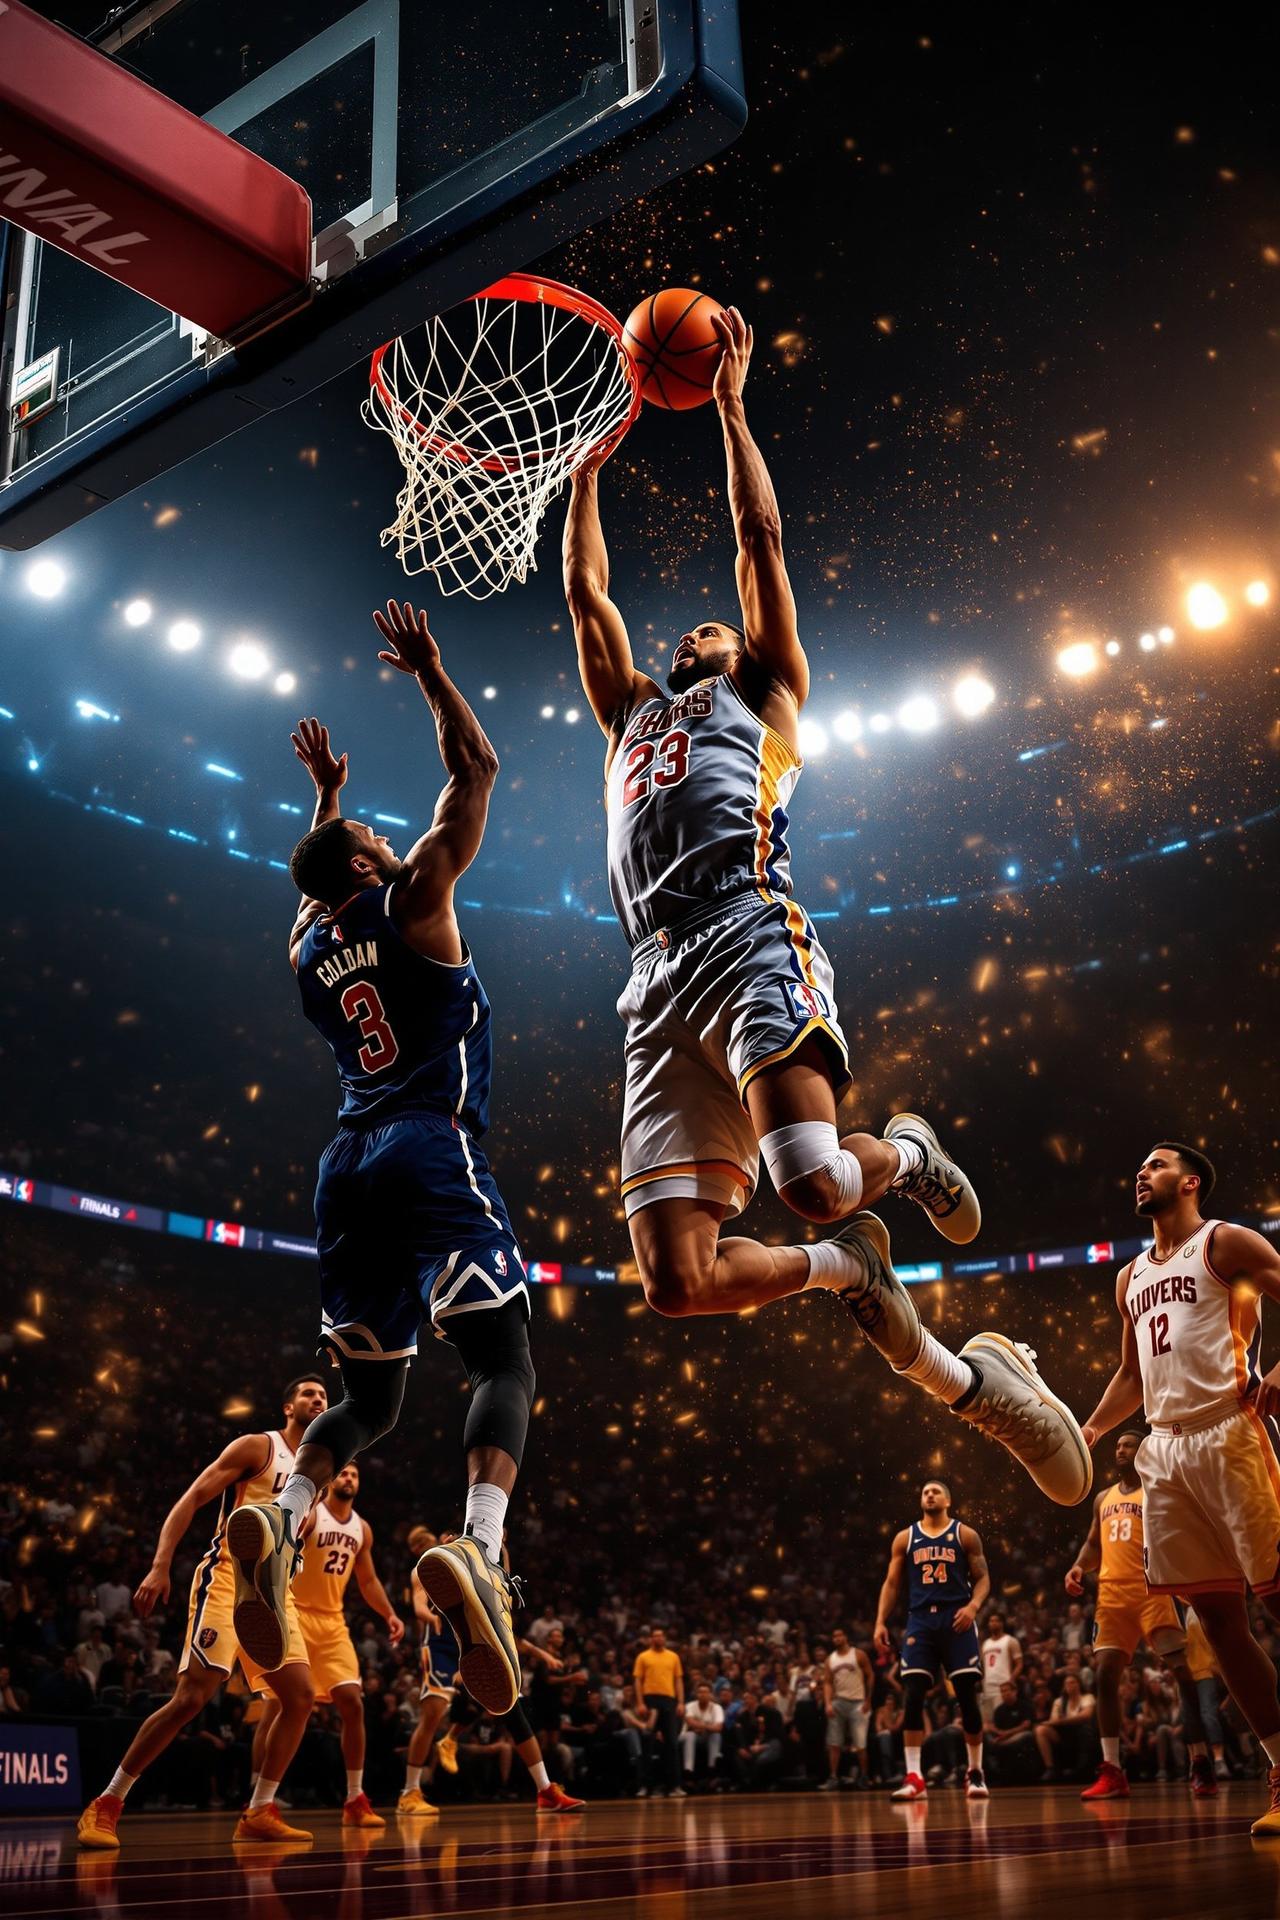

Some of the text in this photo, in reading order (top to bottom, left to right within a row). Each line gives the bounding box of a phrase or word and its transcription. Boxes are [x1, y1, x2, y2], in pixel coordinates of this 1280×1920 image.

[622, 729, 692, 812] 23
[340, 980, 399, 1074] 3
[1148, 1312, 1172, 1358] 12
[1109, 1518, 1132, 1542] 33
[323, 1550, 350, 1576] 23
[922, 1563, 948, 1584] 24
